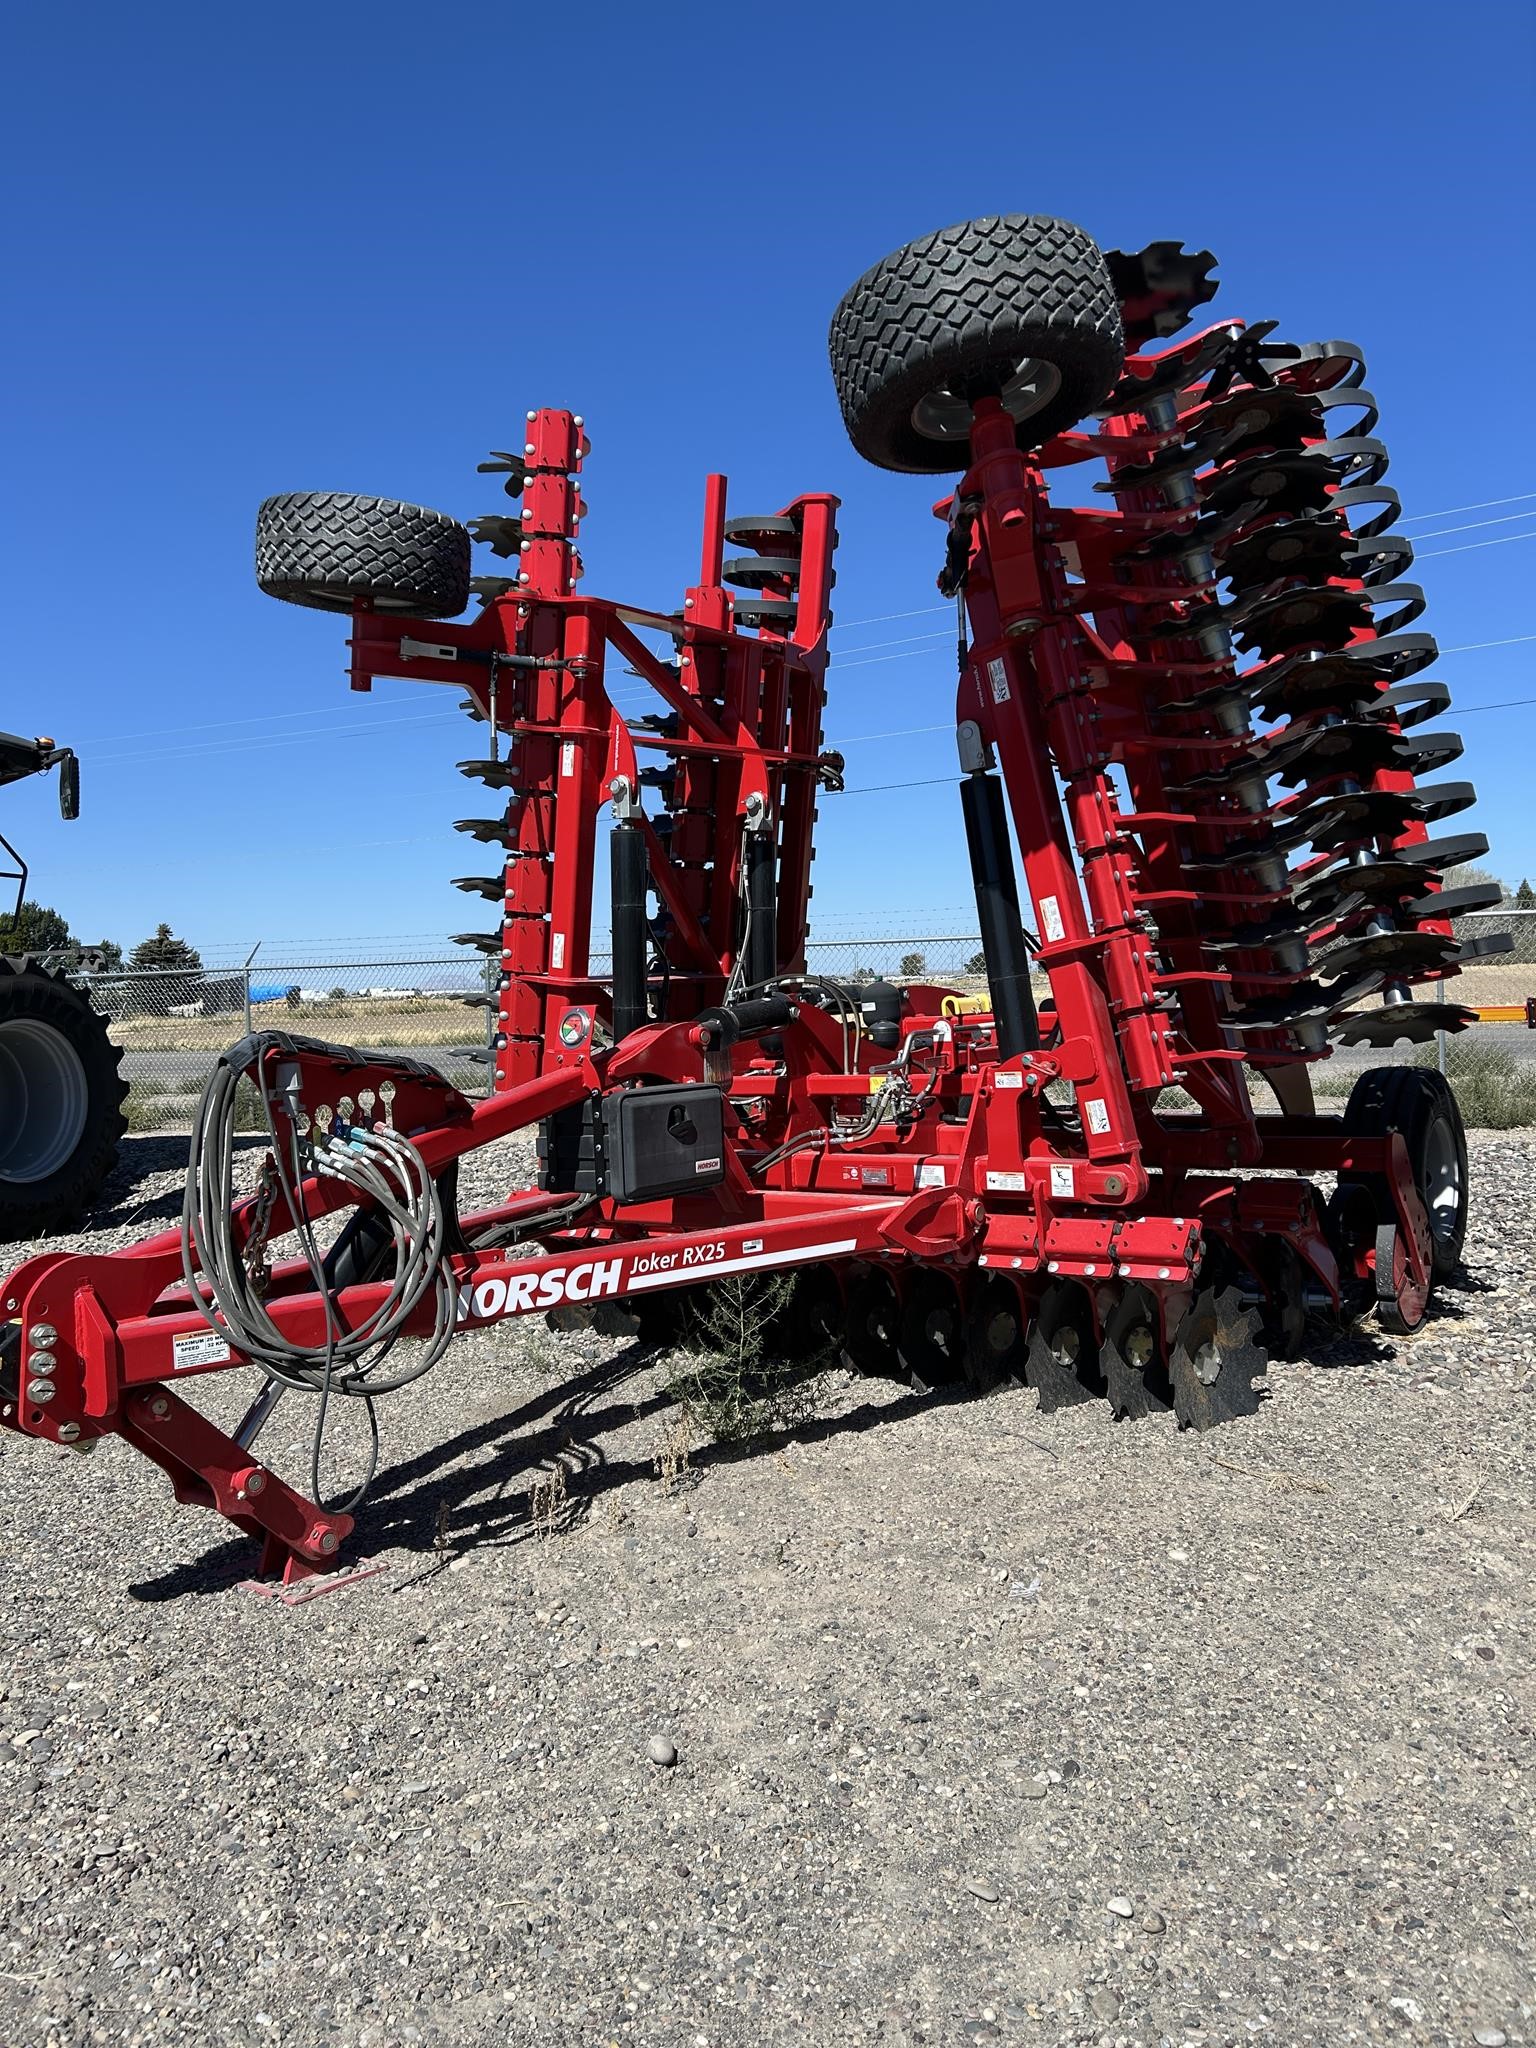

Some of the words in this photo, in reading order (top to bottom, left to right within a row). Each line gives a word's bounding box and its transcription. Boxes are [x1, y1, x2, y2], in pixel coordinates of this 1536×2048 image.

[629, 1252, 679, 1275] Joker
[682, 1241, 726, 1266] RX25
[175, 1338, 205, 1347] MAXIMUM
[181, 1345, 200, 1353] SPEED
